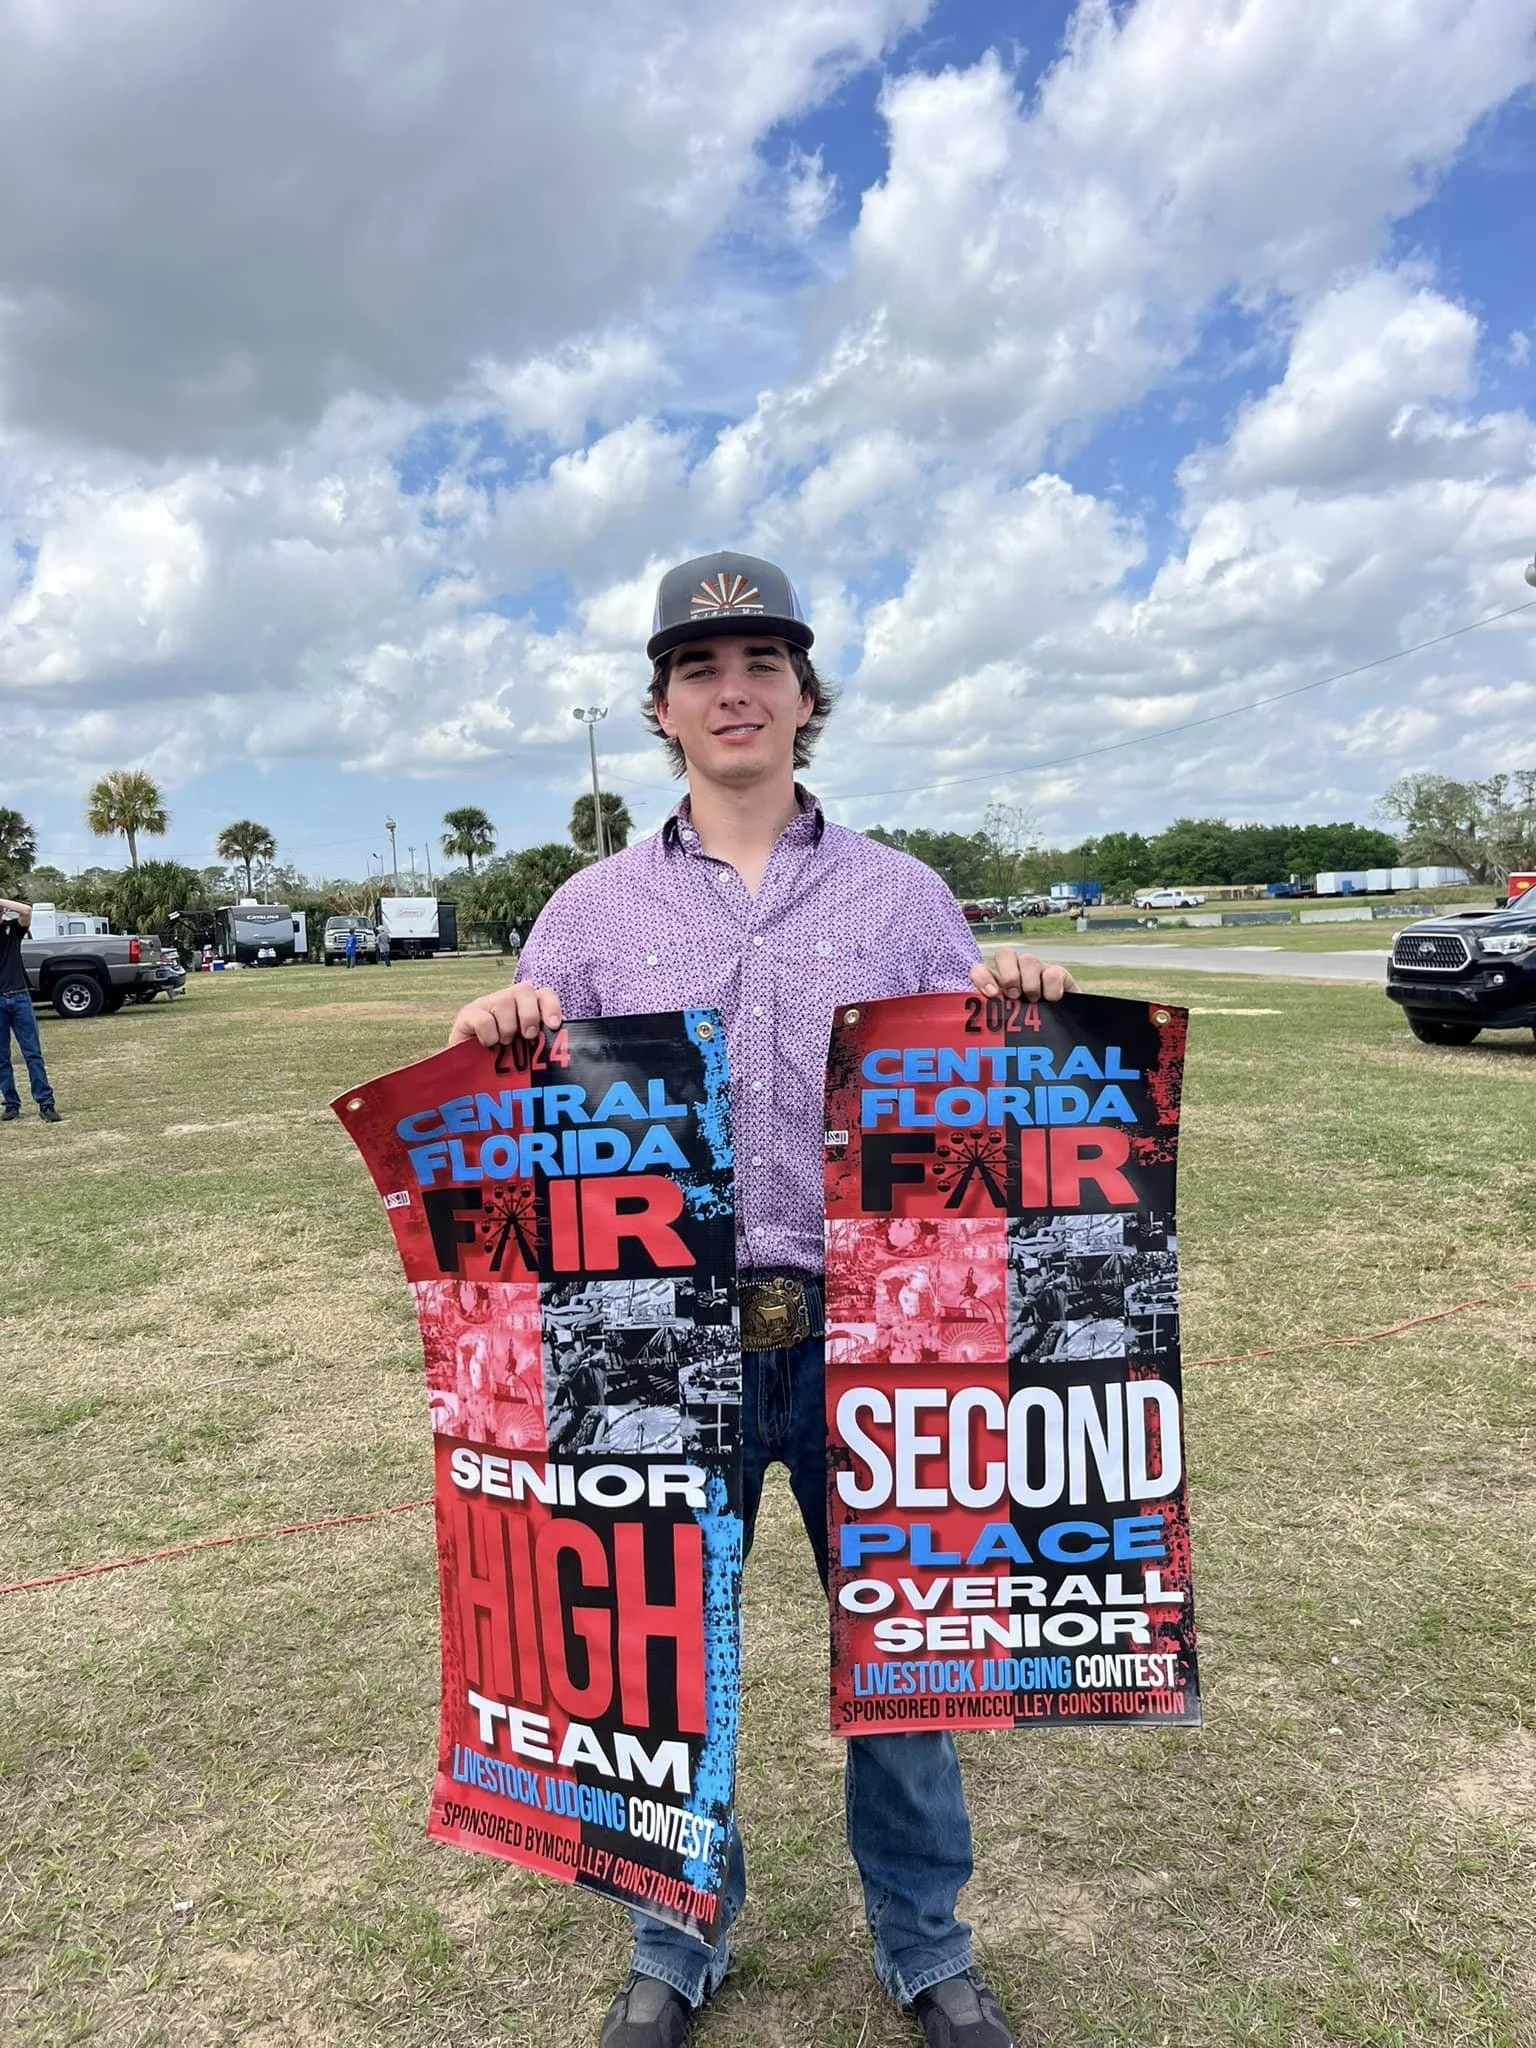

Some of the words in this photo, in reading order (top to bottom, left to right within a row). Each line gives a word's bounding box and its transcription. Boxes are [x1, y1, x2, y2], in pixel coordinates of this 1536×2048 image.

[964, 997, 1042, 1033] 2024
[494, 1028, 571, 1074] 2024
[861, 1046, 1140, 1083] CENTRAL
[396, 1078, 688, 1142] CENTRAL
[861, 1085, 1138, 1128] FLORIDA
[408, 1124, 691, 1186] FLORIDA
[861, 1126, 1140, 1212] FAIR
[422, 1175, 697, 1273] FAIR
[835, 1379, 1183, 1509] SECOND
[450, 1447, 707, 1508] SENIOR
[839, 1515, 1167, 1567] PLACE
[452, 1500, 706, 1734] HIGH
[838, 1571, 1185, 1614] OVERALL
[873, 1611, 1153, 1653] SENIOR
[853, 1659, 975, 1697] LIVESTOCK
[979, 1655, 1072, 1691] JUDGING
[1075, 1653, 1178, 1689] CONTEST
[843, 1698, 941, 1723] SPONSORED
[1058, 1690, 1185, 1717] CONSTRUCTION
[468, 1689, 691, 1794] TEAM
[452, 1743, 542, 1810] LIVESTOCK
[544, 1775, 626, 1832] JUDGING
[628, 1796, 715, 1863] CONTEST
[441, 1801, 522, 1848] SPONSORED
[611, 1856, 717, 1925] CONSTRUCTION
